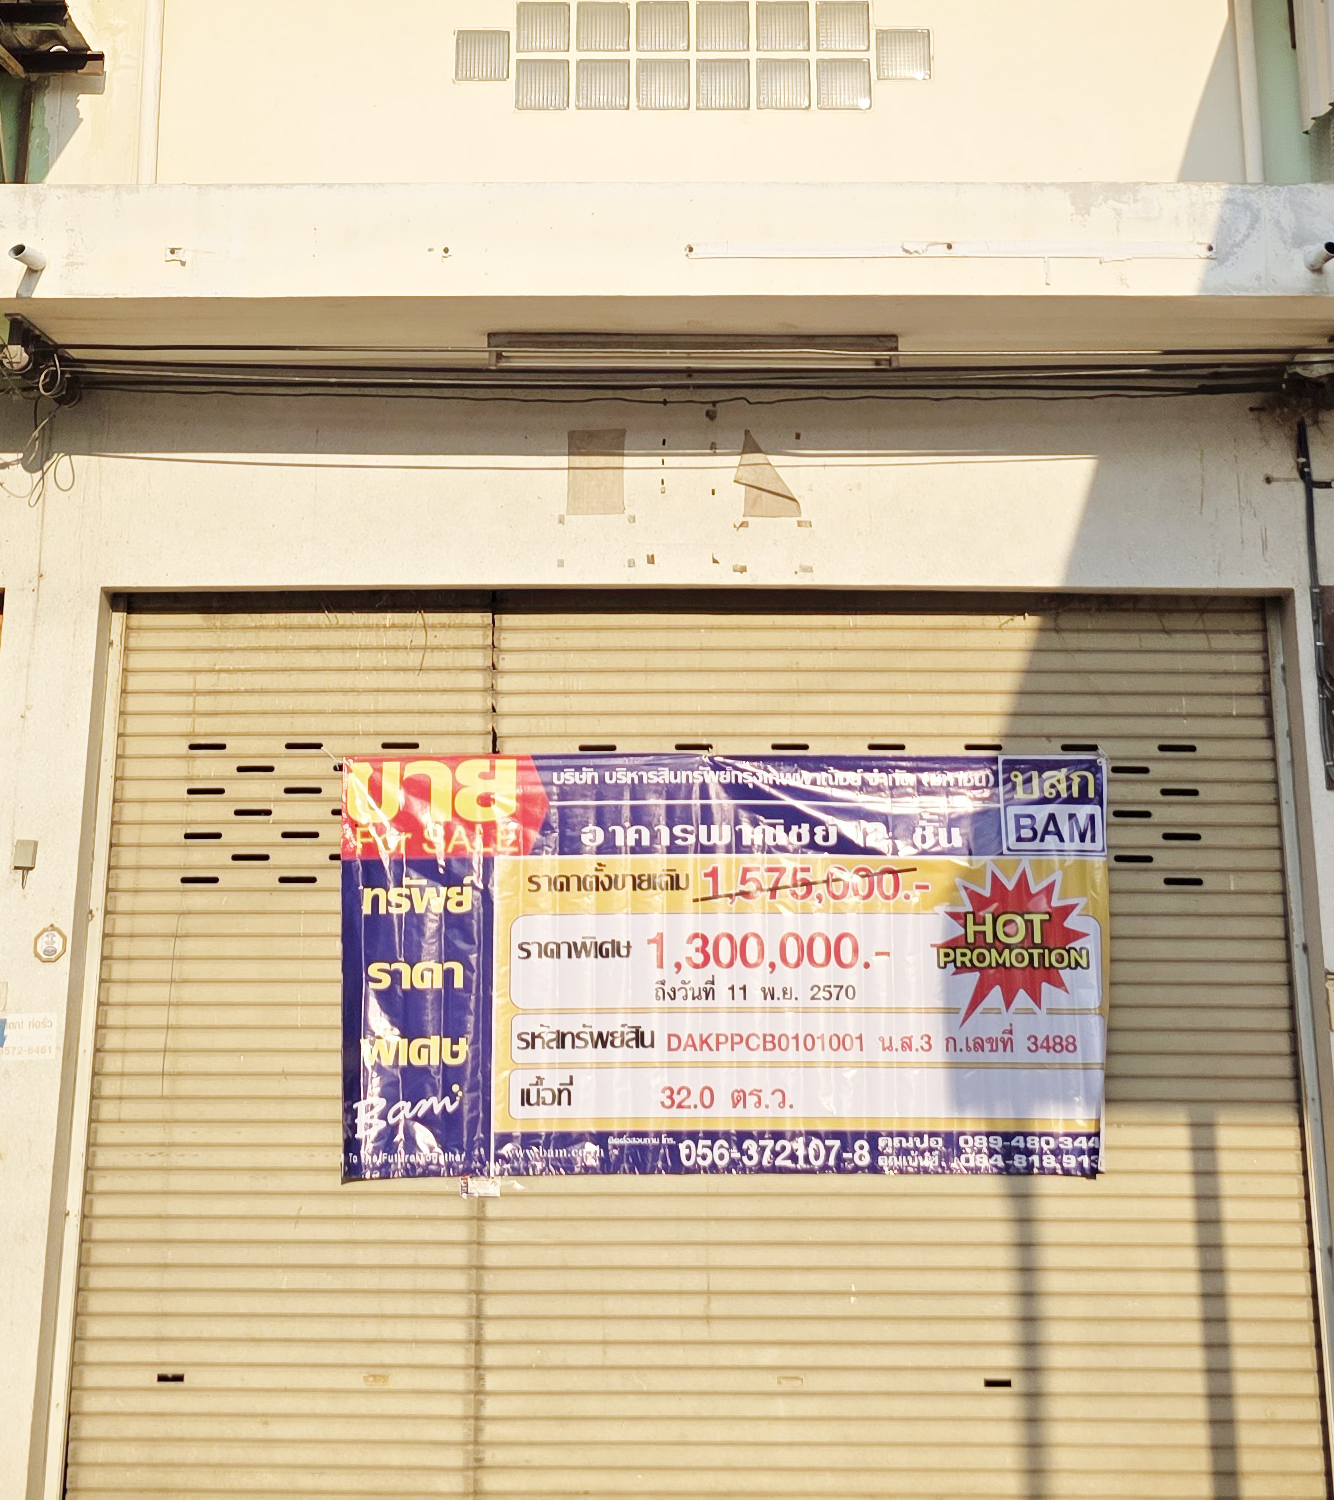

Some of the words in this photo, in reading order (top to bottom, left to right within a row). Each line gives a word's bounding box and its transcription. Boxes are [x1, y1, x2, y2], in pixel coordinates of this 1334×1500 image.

[347, 758, 517, 824] ขาย
[552, 766, 598, 785] บริษัท
[1010, 769, 1096, 799] บสก
[355, 827, 412, 855] For
[422, 824, 518, 854] SALE
[1013, 812, 1096, 844] BAM
[528, 862, 689, 893] ราคาตั้งขายเดิม
[362, 876, 473, 915] ทรัพย์
[965, 912, 1051, 945] HOT
[517, 935, 632, 961] ราคาพิเศษ
[647, 932, 890, 975] 1,300,000.-
[938, 947, 1090, 969] PROMOTION
[367, 961, 464, 990] ราคา
[654, 975, 715, 1002] ถึงวันที่
[727, 985, 747, 1001] 11
[760, 985, 799, 1001] พ.ย.
[809, 984, 856, 1001] 2570
[360, 1032, 469, 1067] พเศษ
[517, 1024, 655, 1050] รหัสทรัพย์สิน
[667, 1033, 864, 1052] DAKPPCB0101001
[1026, 1034, 1078, 1053] 3488
[520, 1075, 574, 1107] เนื้อที่
[659, 1085, 715, 1109] 32.0
[730, 1086, 794, 1109] ตร.ว.
[352, 1093, 460, 1140] Bam
[348, 1153, 358, 1163] To
[419, 1152, 466, 1163] Togther
[680, 1139, 871, 1167] 056-372107-8
